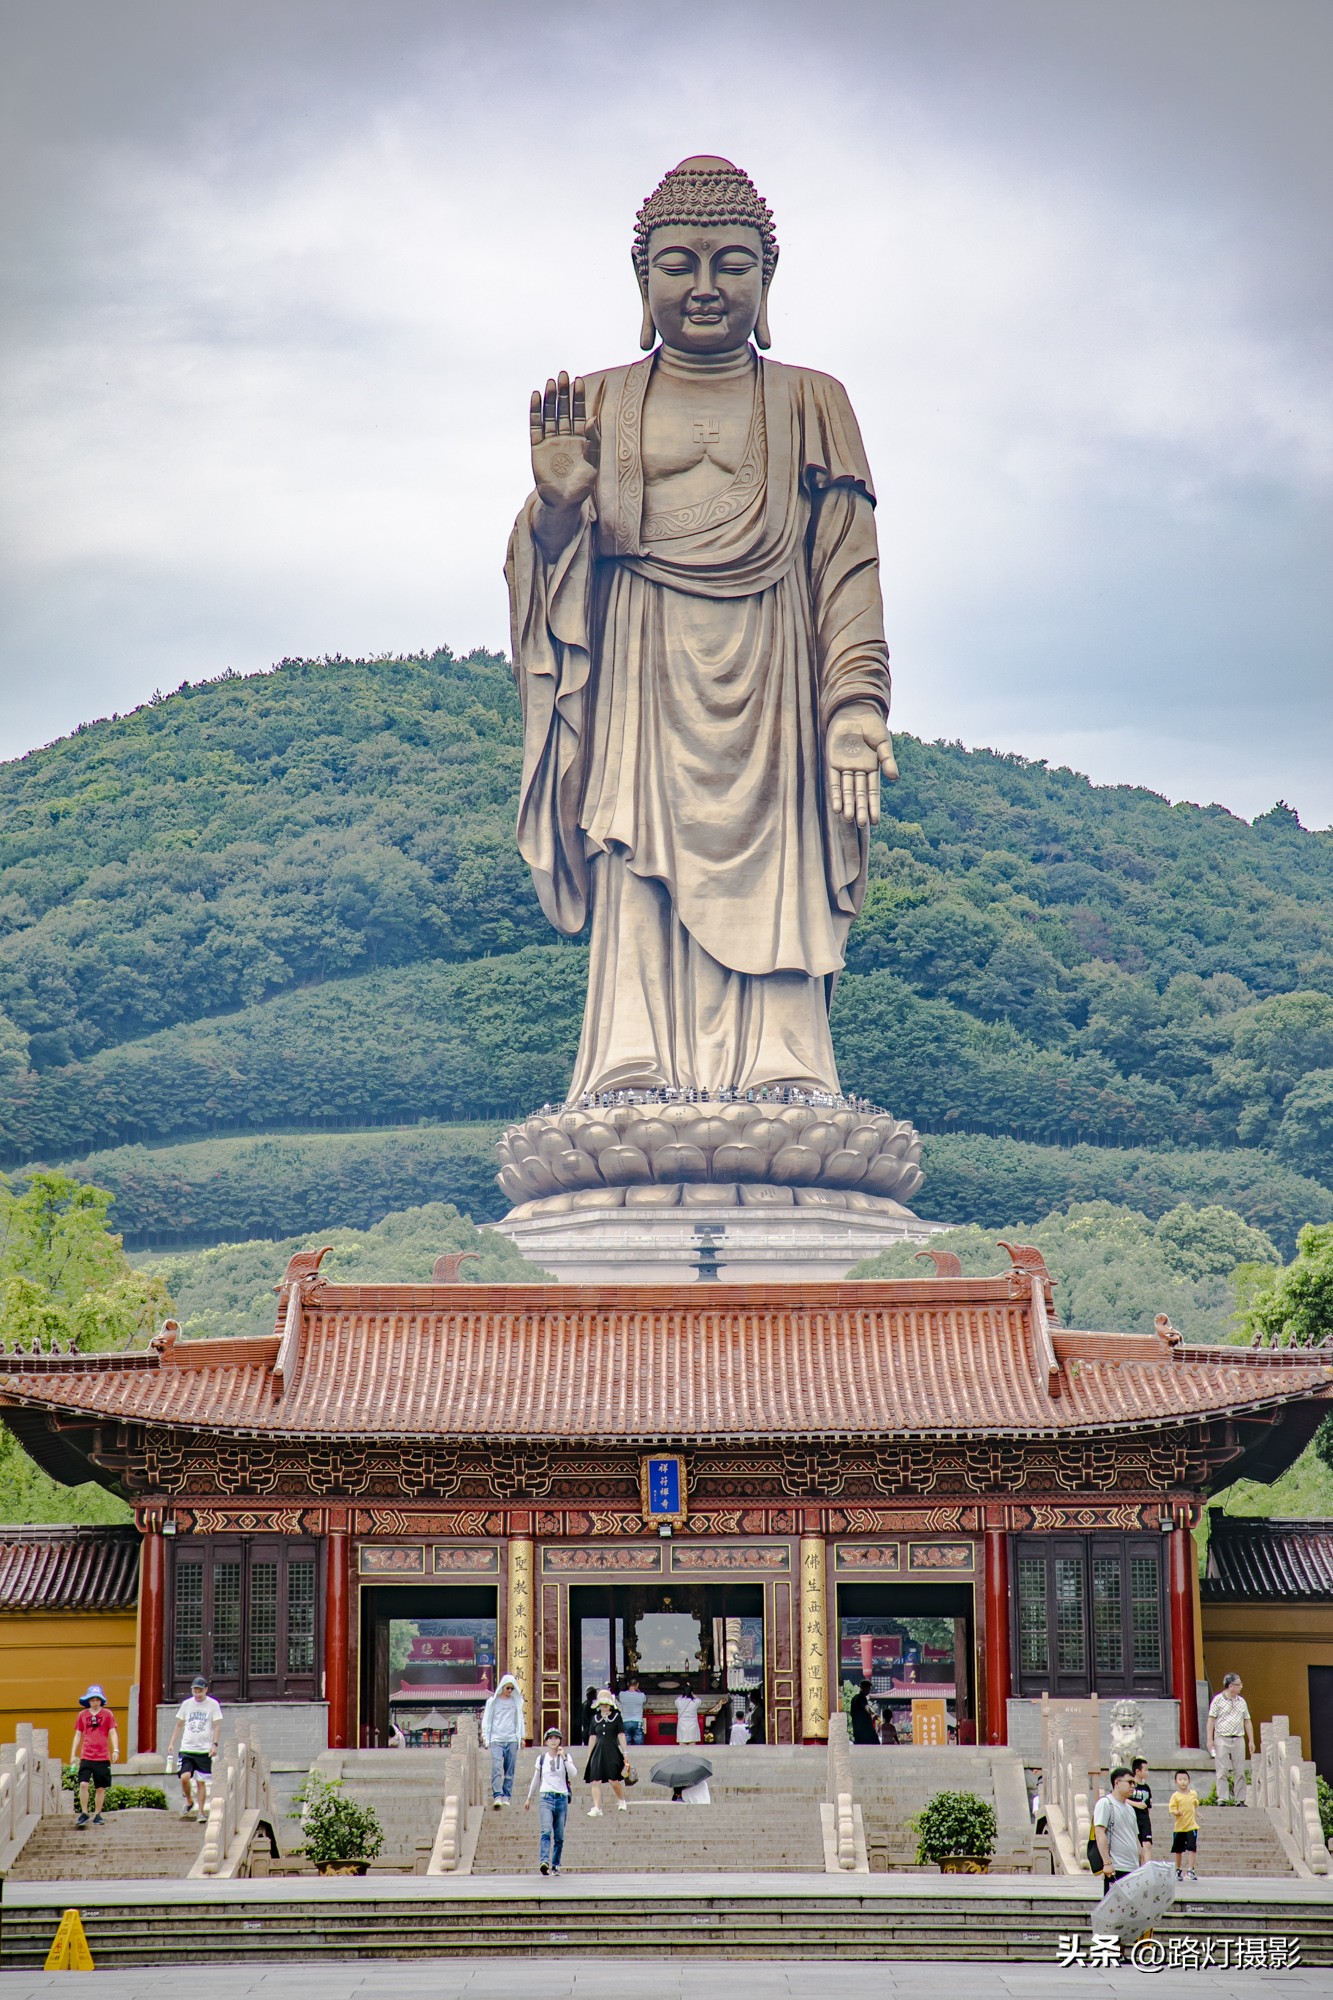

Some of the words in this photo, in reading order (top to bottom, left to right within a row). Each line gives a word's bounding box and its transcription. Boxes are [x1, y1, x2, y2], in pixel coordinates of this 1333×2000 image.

[513, 1556, 529, 1726] 聖教東流地氣
[804, 1554, 825, 1724] 佛生西域天運開泰
